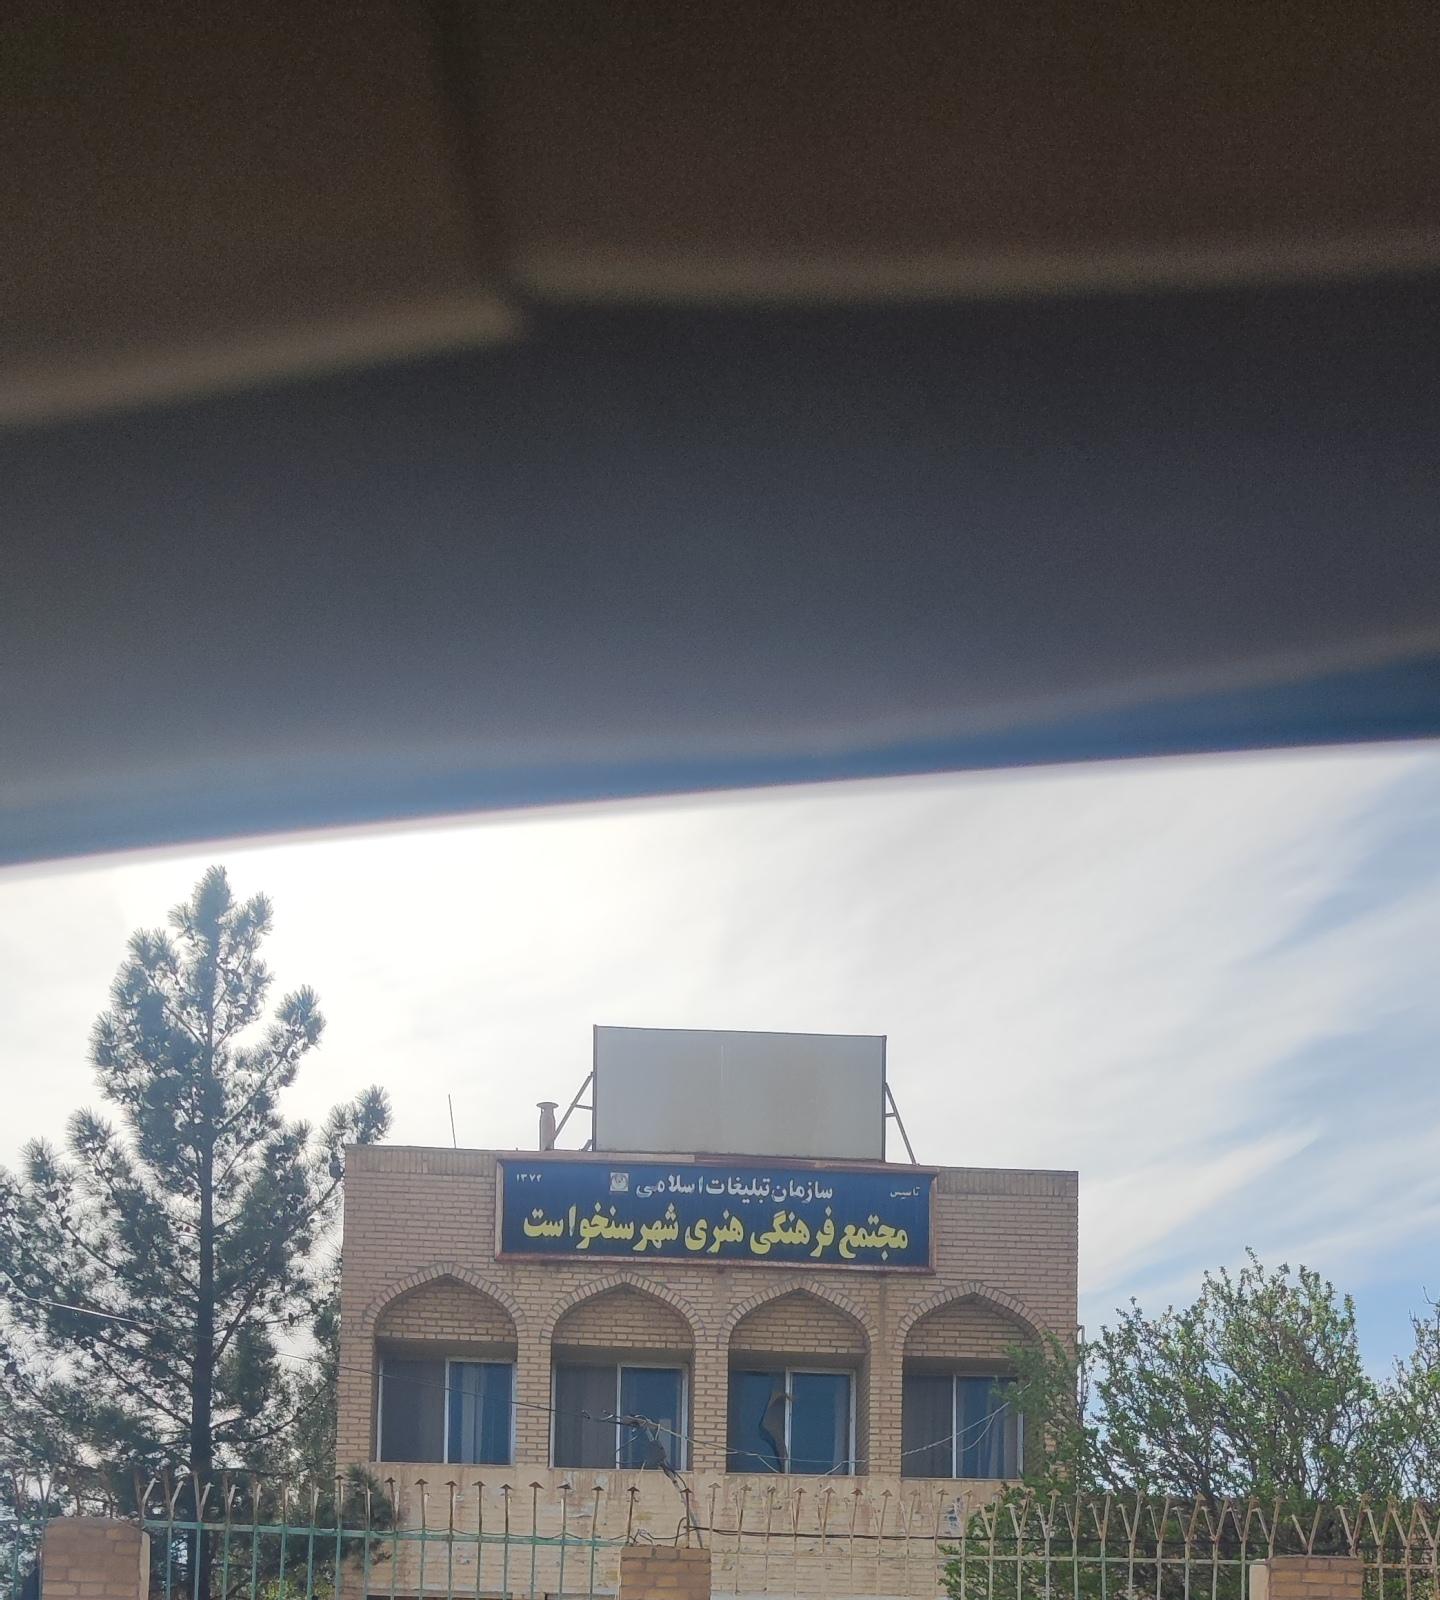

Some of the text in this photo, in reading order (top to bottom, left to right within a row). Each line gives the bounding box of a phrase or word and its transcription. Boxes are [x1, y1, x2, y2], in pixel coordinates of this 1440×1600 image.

[635, 1175, 833, 1204] سازمان تبلیغات اسلامی
[684, 1209, 744, 1254] هنری
[750, 1206, 835, 1257] فرهنگی
[838, 1214, 910, 1261] مجتمع
